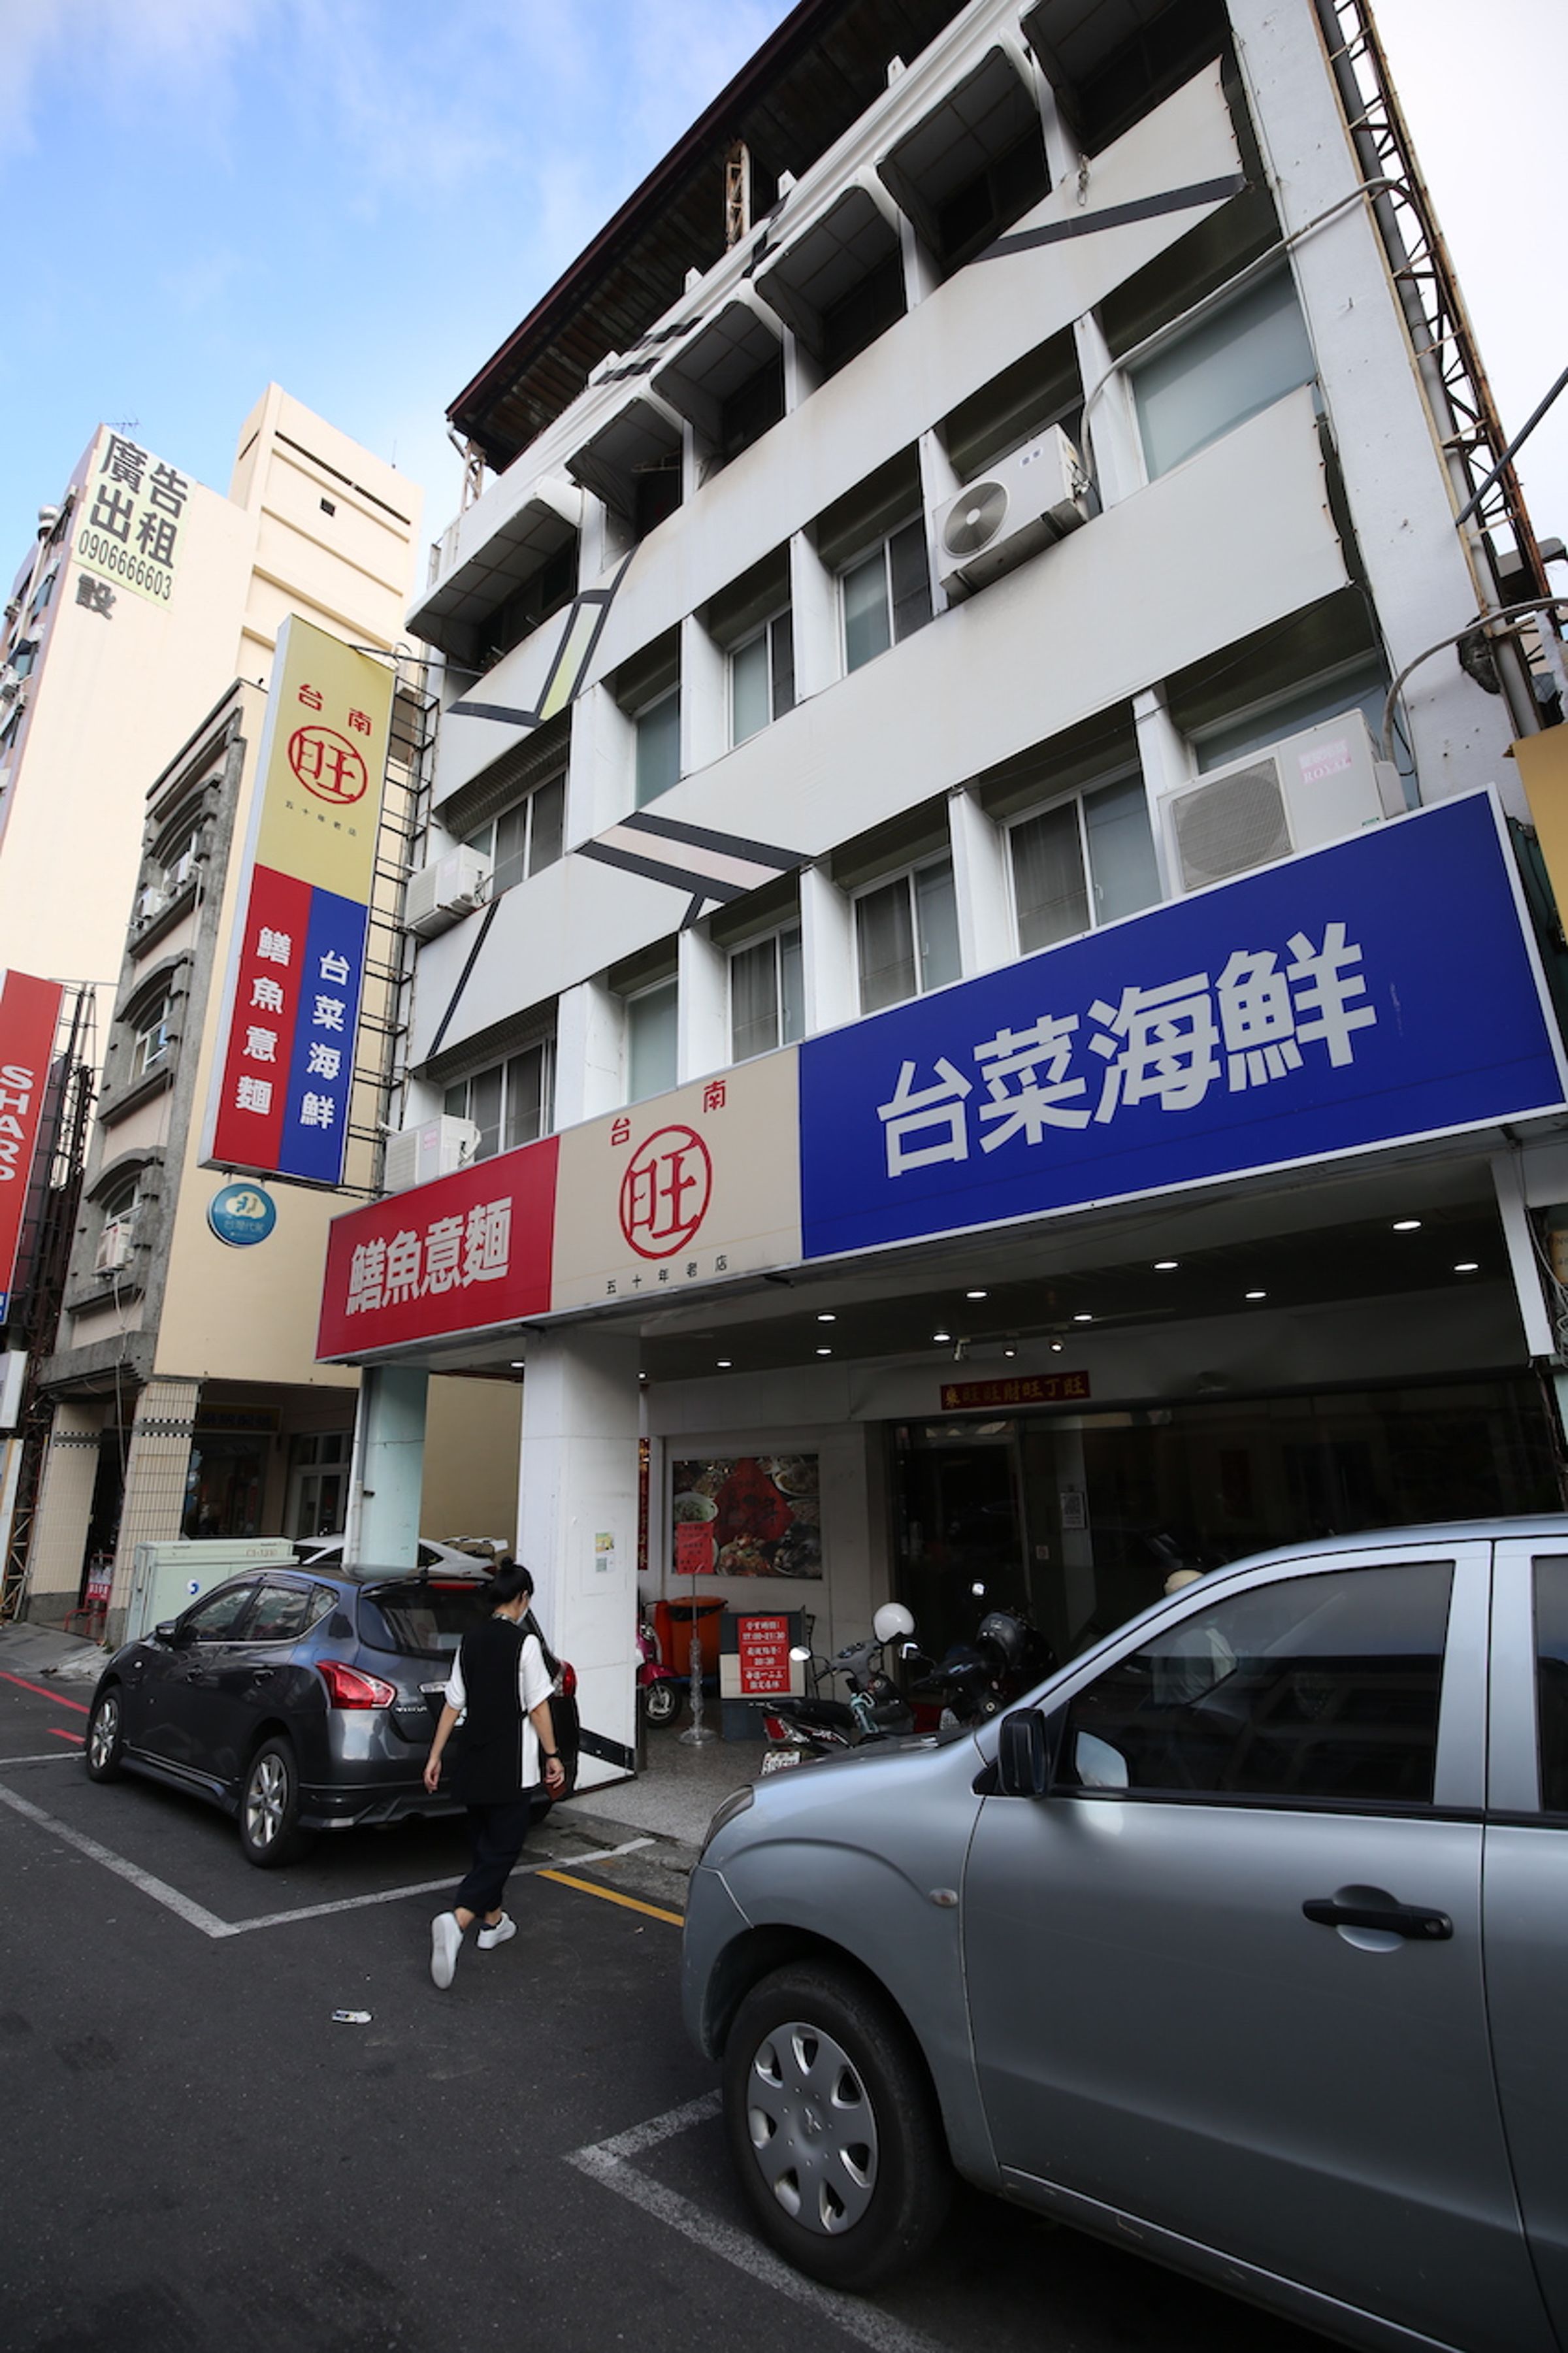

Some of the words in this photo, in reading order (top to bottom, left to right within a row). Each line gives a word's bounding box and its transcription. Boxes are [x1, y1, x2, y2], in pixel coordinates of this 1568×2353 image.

[99, 433, 189, 519] 廣告
[78, 529, 174, 601] 0906666603
[90, 484, 178, 569] 出租
[74, 572, 117, 621] 設
[294, 729, 361, 802] 旺
[235, 926, 293, 1117] 鱔魚意麵
[299, 949, 353, 1130] 台菜海鮮
[875, 921, 1378, 1179] 台菜海鮮
[624, 1130, 704, 1245] 旺
[346, 1196, 512, 1316] 鱔魚意麵
[606, 1254, 728, 1296] 五十年老店
